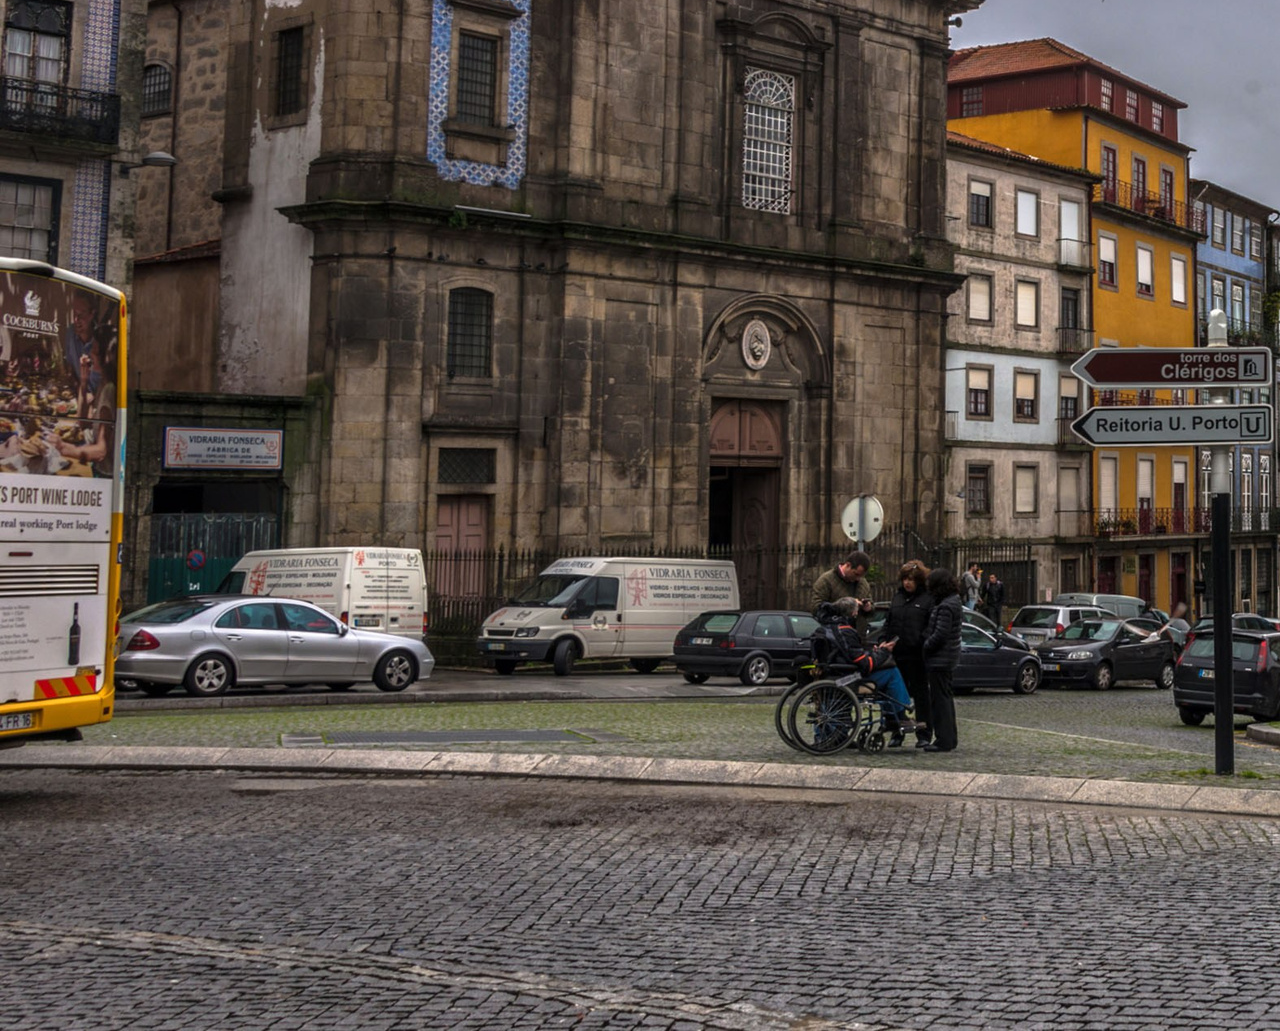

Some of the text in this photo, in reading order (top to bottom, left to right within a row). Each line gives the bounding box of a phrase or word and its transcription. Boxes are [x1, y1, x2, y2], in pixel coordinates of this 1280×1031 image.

[1180, 353, 1237, 363] torre dos
[1161, 364, 1237, 382] Clérigos
[1096, 416, 1239, 433] Reitoria U. Porto
[189, 435, 266, 445] VIDRARIA FONSECA
[11, 487, 39, 504] PORT
[41, 488, 68, 505] WINE
[71, 489, 103, 507] LODGE
[1, 518, 98, 532] real working Port lodge
[269, 557, 338, 568] VIDRARIA FONSECA
[649, 568, 730, 579] VIDRARIA FONSECA
